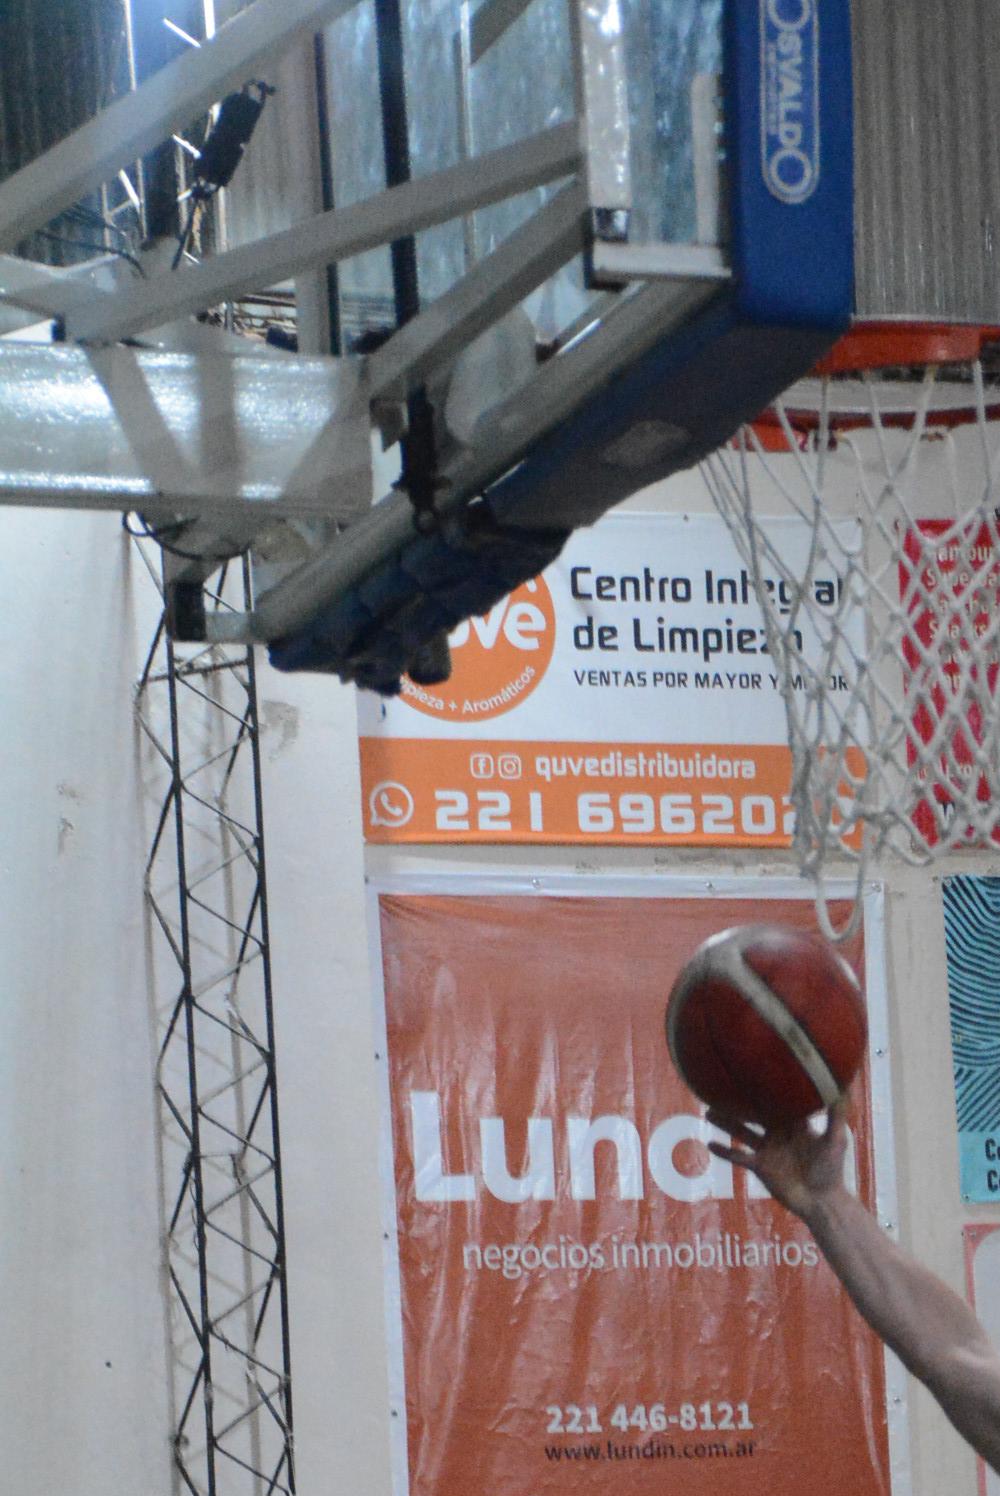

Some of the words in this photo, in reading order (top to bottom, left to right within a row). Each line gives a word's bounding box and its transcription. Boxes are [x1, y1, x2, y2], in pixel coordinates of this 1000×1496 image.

[570, 566, 691, 602] Centro
[573, 616, 619, 651] de
[462, 665, 536, 715] Aromáticos
[574, 670, 648, 688] VENTAS
[653, 671, 688, 688] POR
[695, 672, 762, 690] MAYOR
[769, 674, 779, 690] Y
[535, 751, 757, 783] quvedistribuidora
[434, 790, 544, 832] 221
[462, 1237, 604, 1279] negocios
[612, 1233, 819, 1271] inmobiliarios
[546, 1403, 600, 1435] 221
[611, 1402, 754, 1434] 446-8121
[544, 1438, 758, 1462] www.lundin.com.ar
